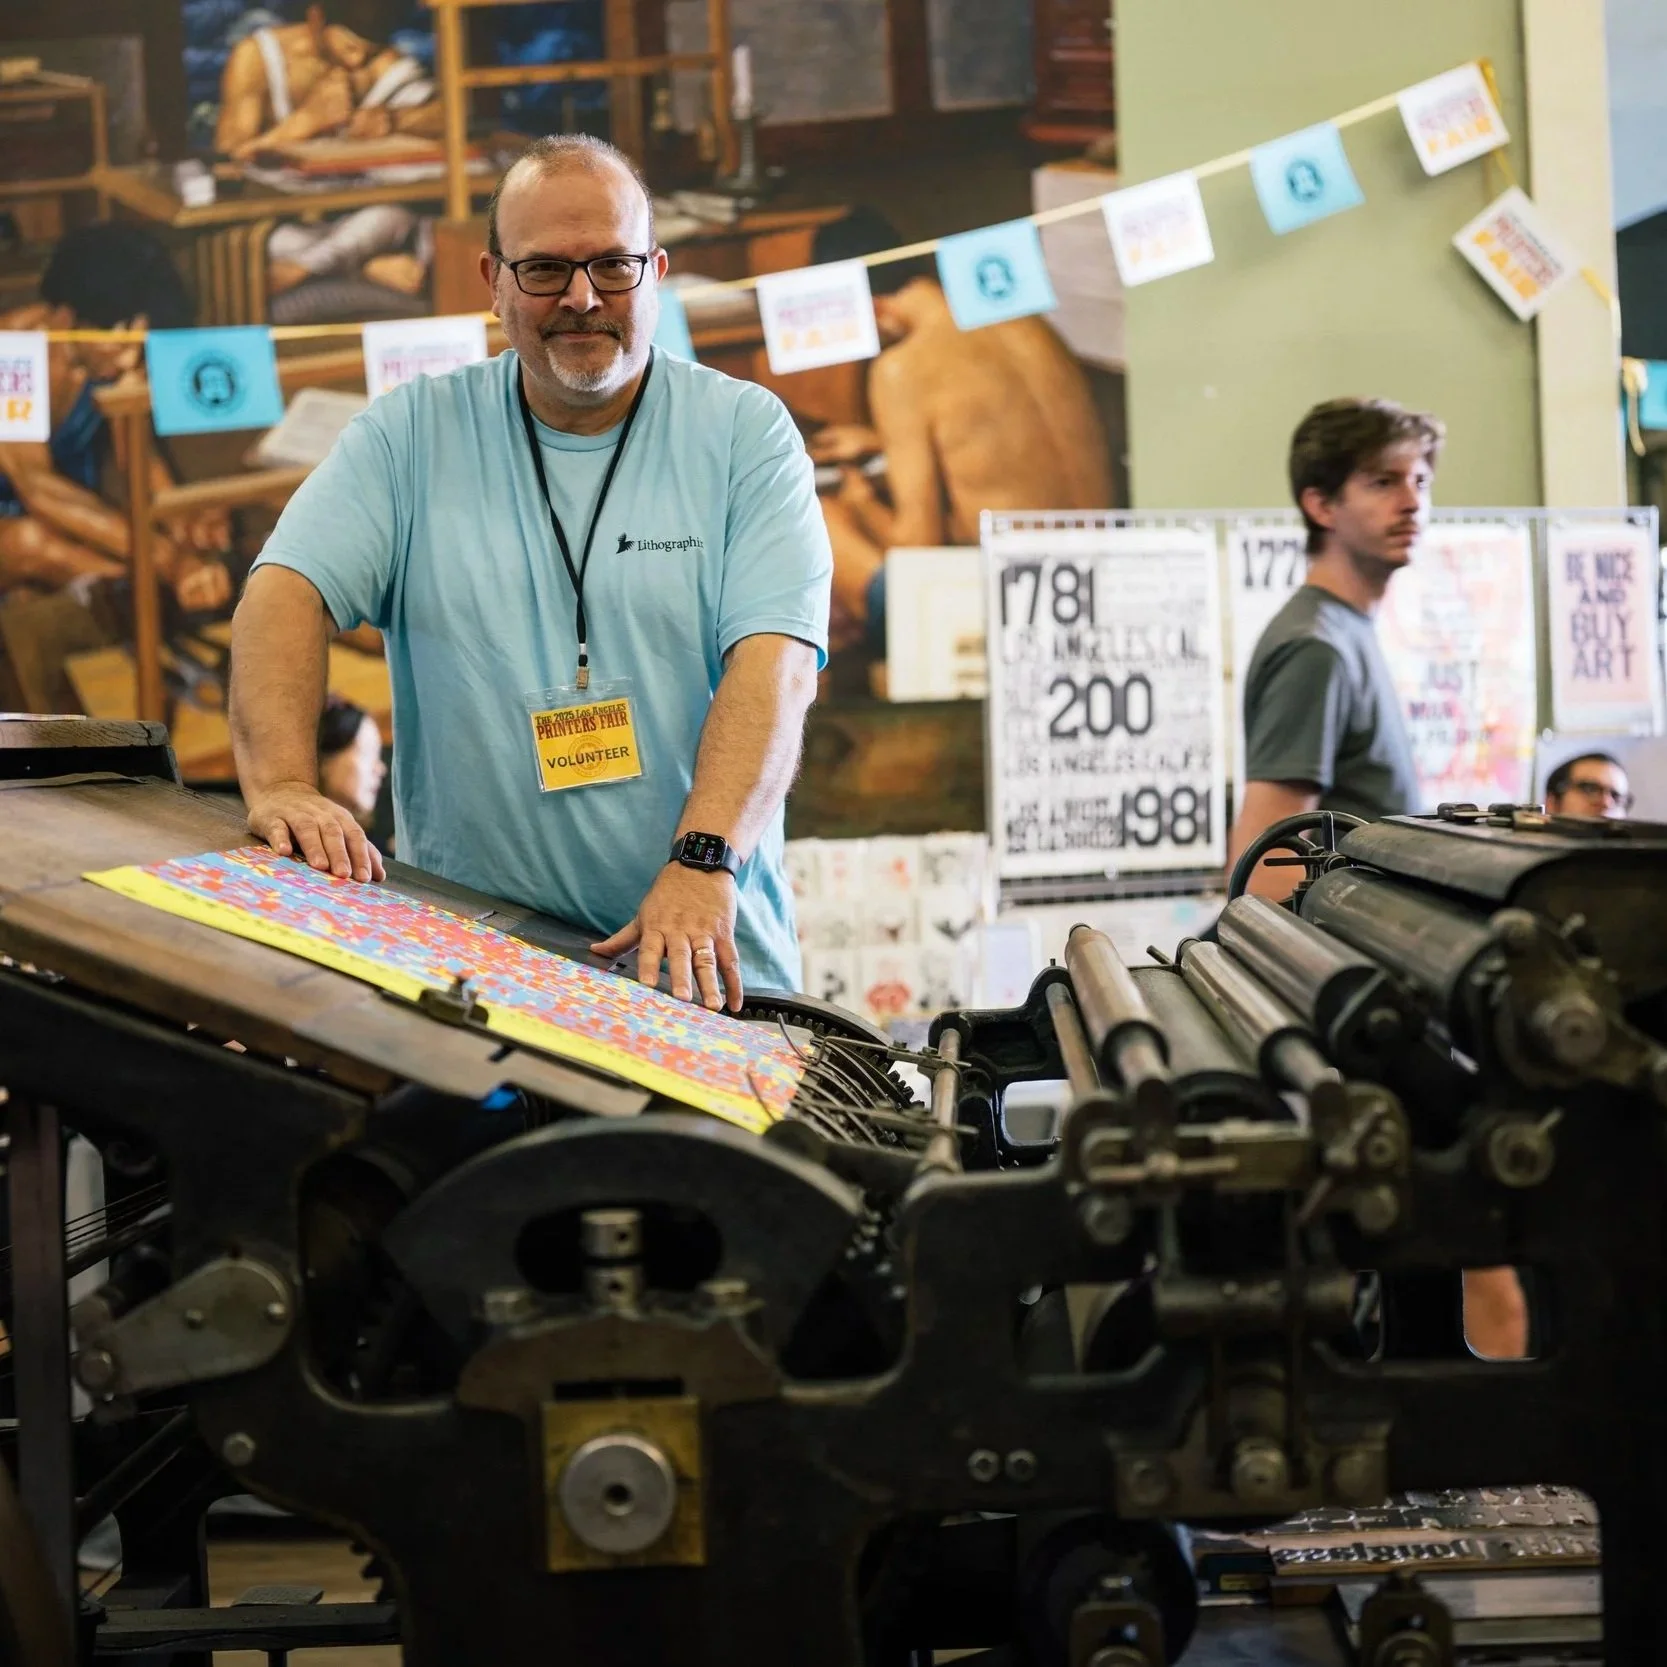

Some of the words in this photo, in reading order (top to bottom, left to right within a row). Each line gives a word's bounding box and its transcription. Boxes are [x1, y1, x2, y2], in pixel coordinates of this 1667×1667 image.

[1594, 550, 1634, 582] NICE
[1001, 563, 1094, 626] 1781
[1579, 587, 1627, 604] AND
[1571, 611, 1632, 644] BUY
[1572, 645, 1636, 680] ART
[535, 716, 553, 726] THE
[553, 711, 575, 722] 2025
[1049, 674, 1153, 738] 200
[537, 715, 597, 740] PRINTERS
[598, 711, 629, 730] FAIR
[546, 746, 630, 769] VOLUNTEER
[1122, 786, 1212, 847] 1981
